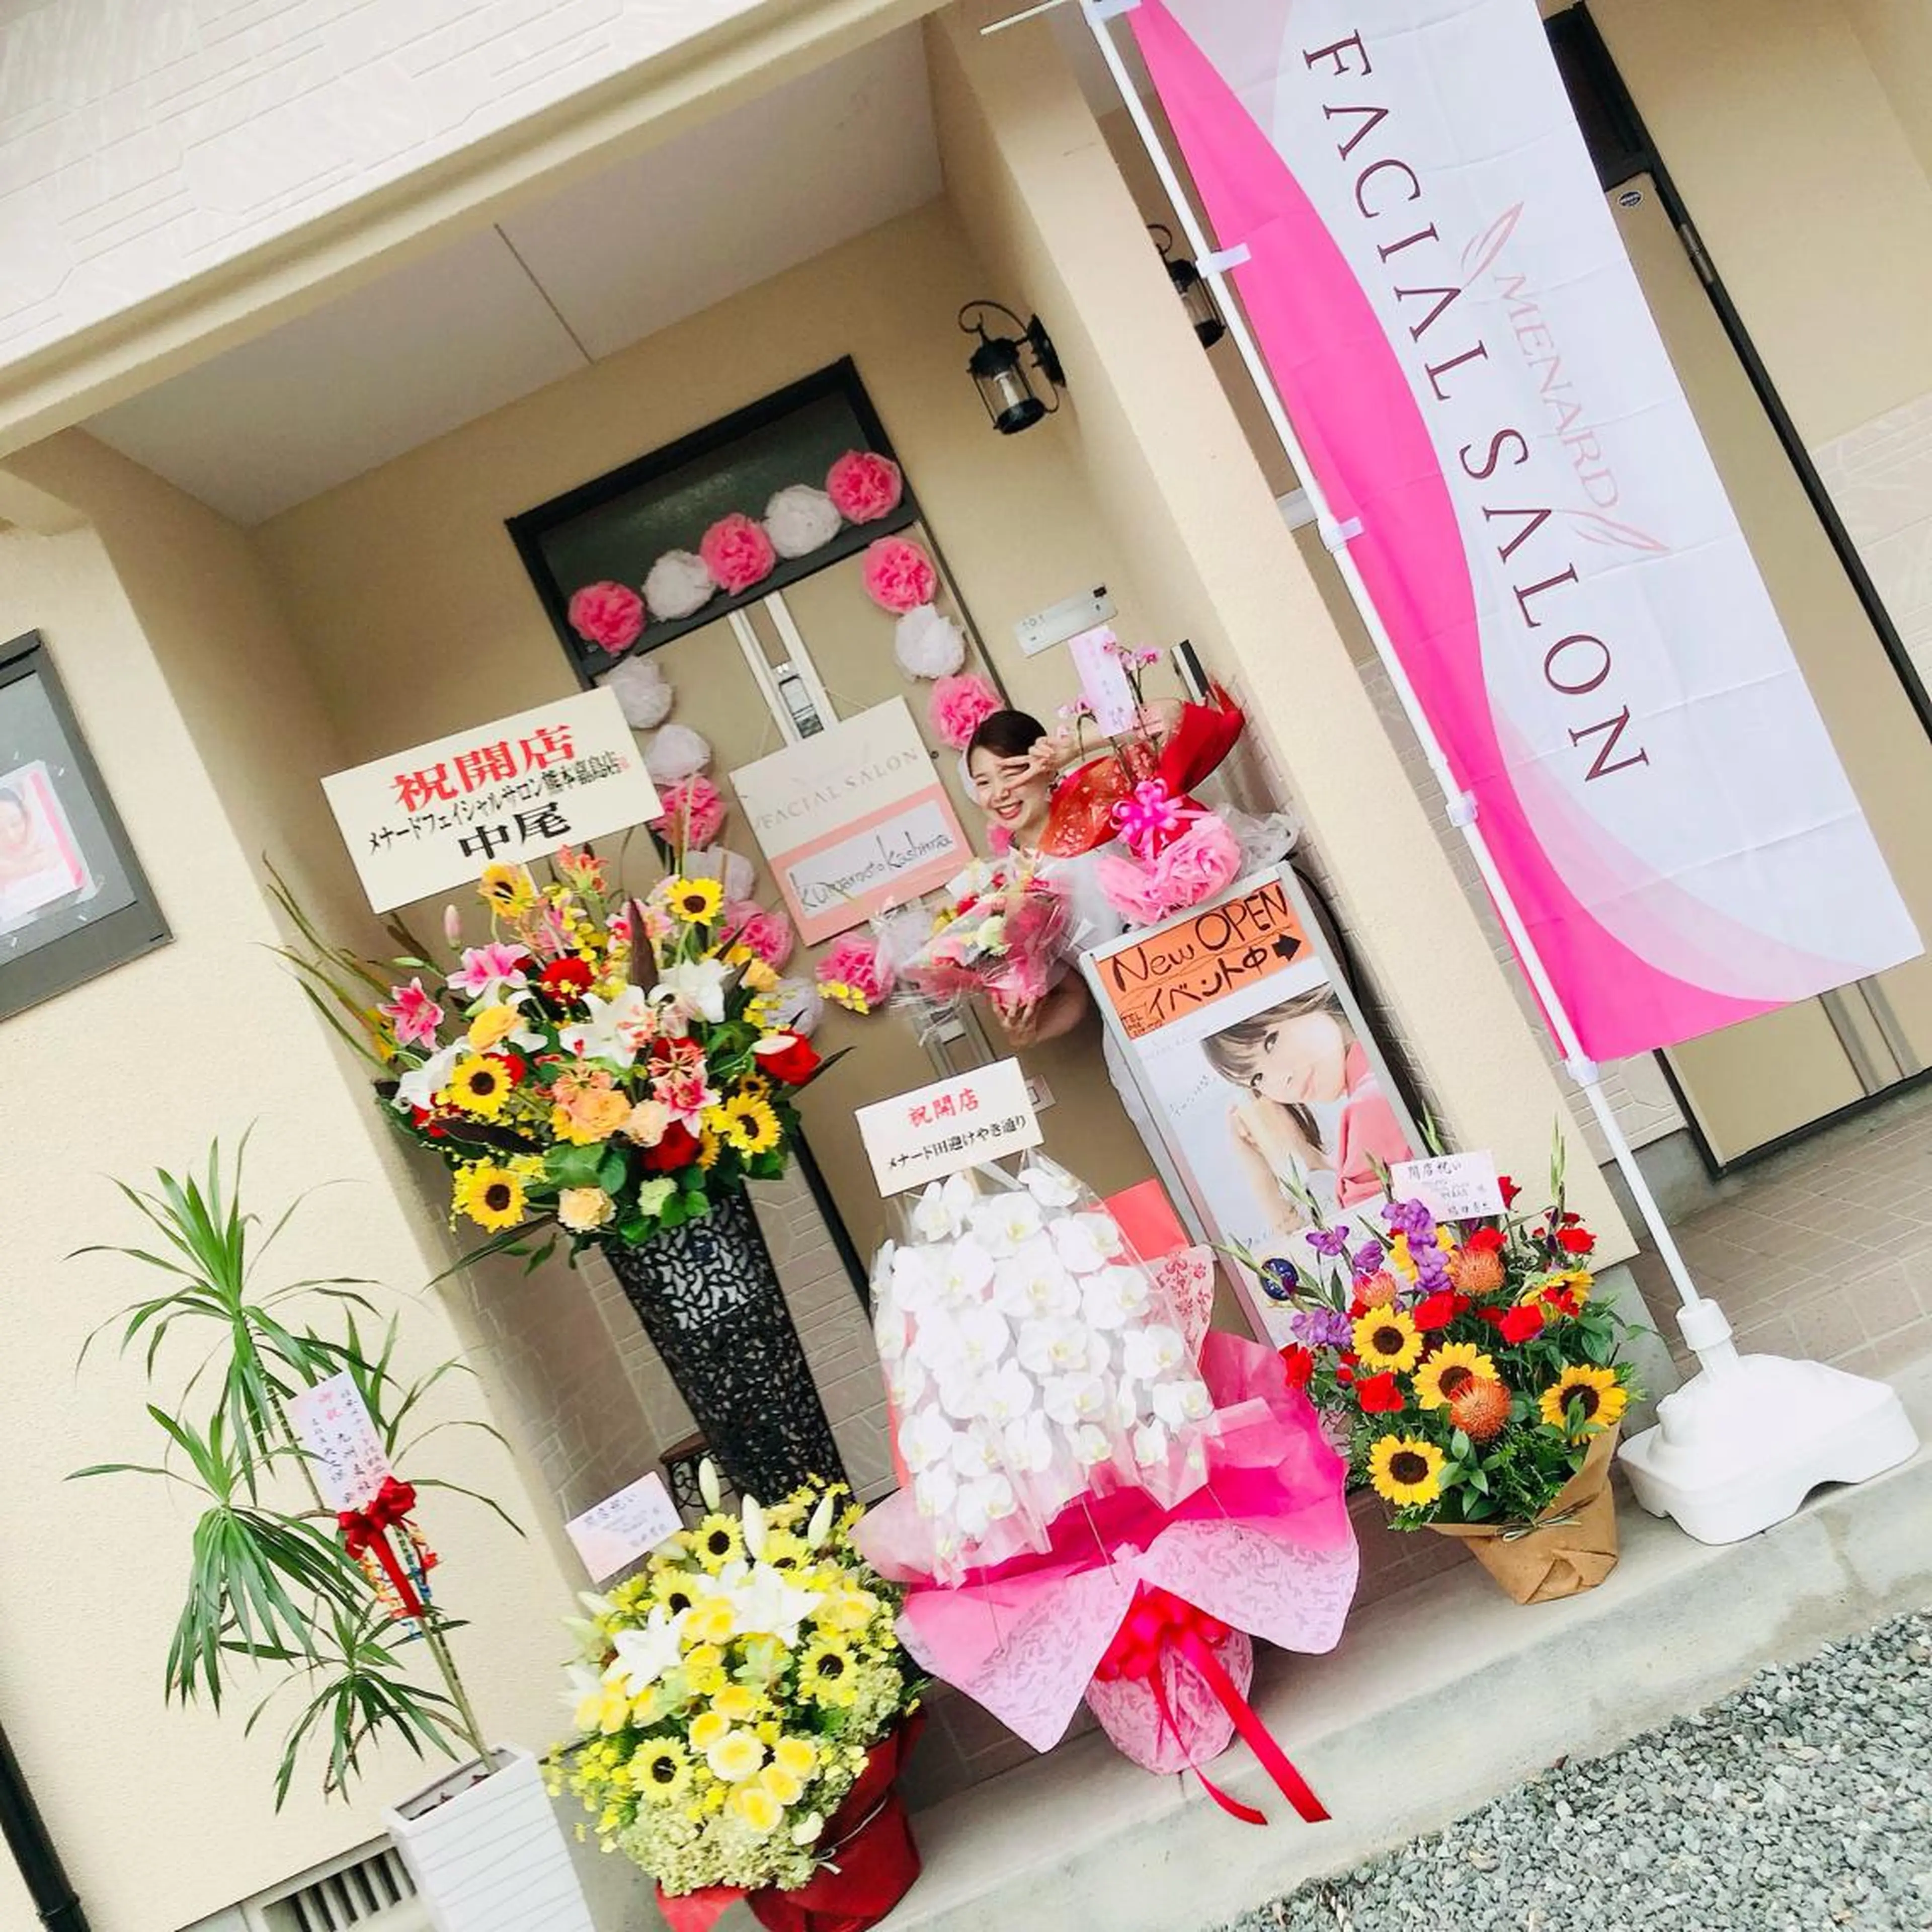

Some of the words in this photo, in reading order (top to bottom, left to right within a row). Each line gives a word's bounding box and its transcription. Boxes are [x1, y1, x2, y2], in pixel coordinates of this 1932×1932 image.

[1303, 29, 1488, 401] FACIAL
[1459, 428, 1650, 782] SALON
[1493, 272, 1619, 510] MENARD
[392, 723, 576, 813] 祝開店
[760, 786, 840, 829] FACIAL
[845, 749, 919, 789] SALON
[457, 801, 572, 860] 中尾
[1113, 944, 1194, 992] New
[1195, 884, 1289, 951] OPEN
[1149, 946, 1267, 1021] イベント中
[907, 1087, 981, 1128] 祝開店
